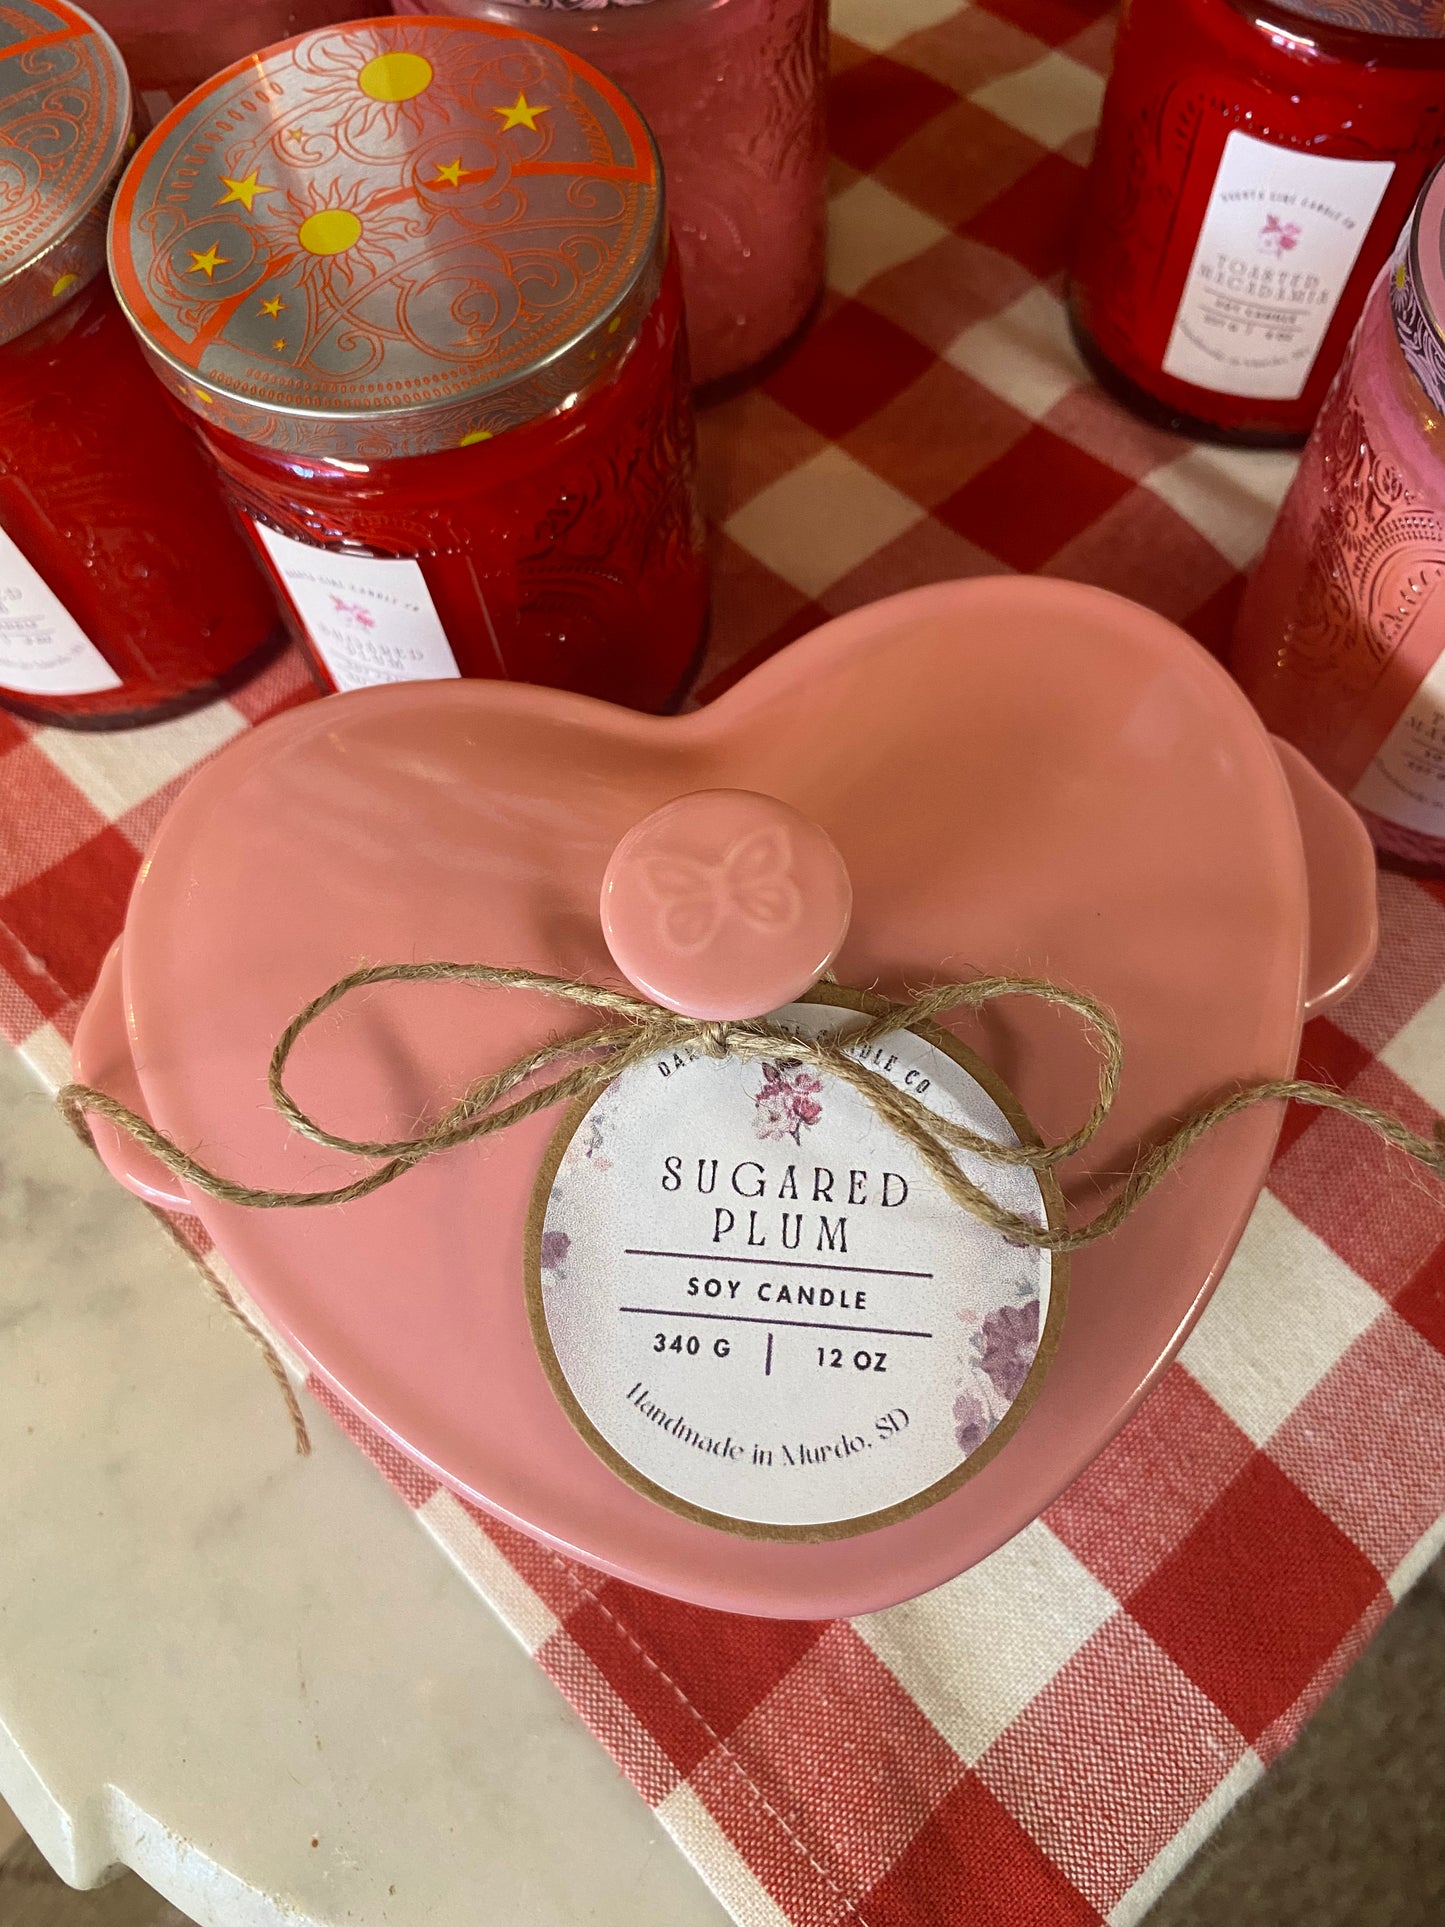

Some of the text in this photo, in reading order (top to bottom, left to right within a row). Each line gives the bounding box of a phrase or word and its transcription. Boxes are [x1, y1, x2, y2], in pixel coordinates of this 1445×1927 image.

[904, 1068, 931, 1095] CO
[661, 1155, 910, 1209] SUGARED
[712, 1207, 848, 1253] PLUM
[687, 1276, 867, 1311] SOY CANDLE
[653, 1333, 731, 1358] 340 G
[817, 1346, 888, 1373] 12 OZ
[626, 1382, 745, 1461] Handmade
[752, 1443, 773, 1467] in
[875, 1407, 910, 1441] SD
